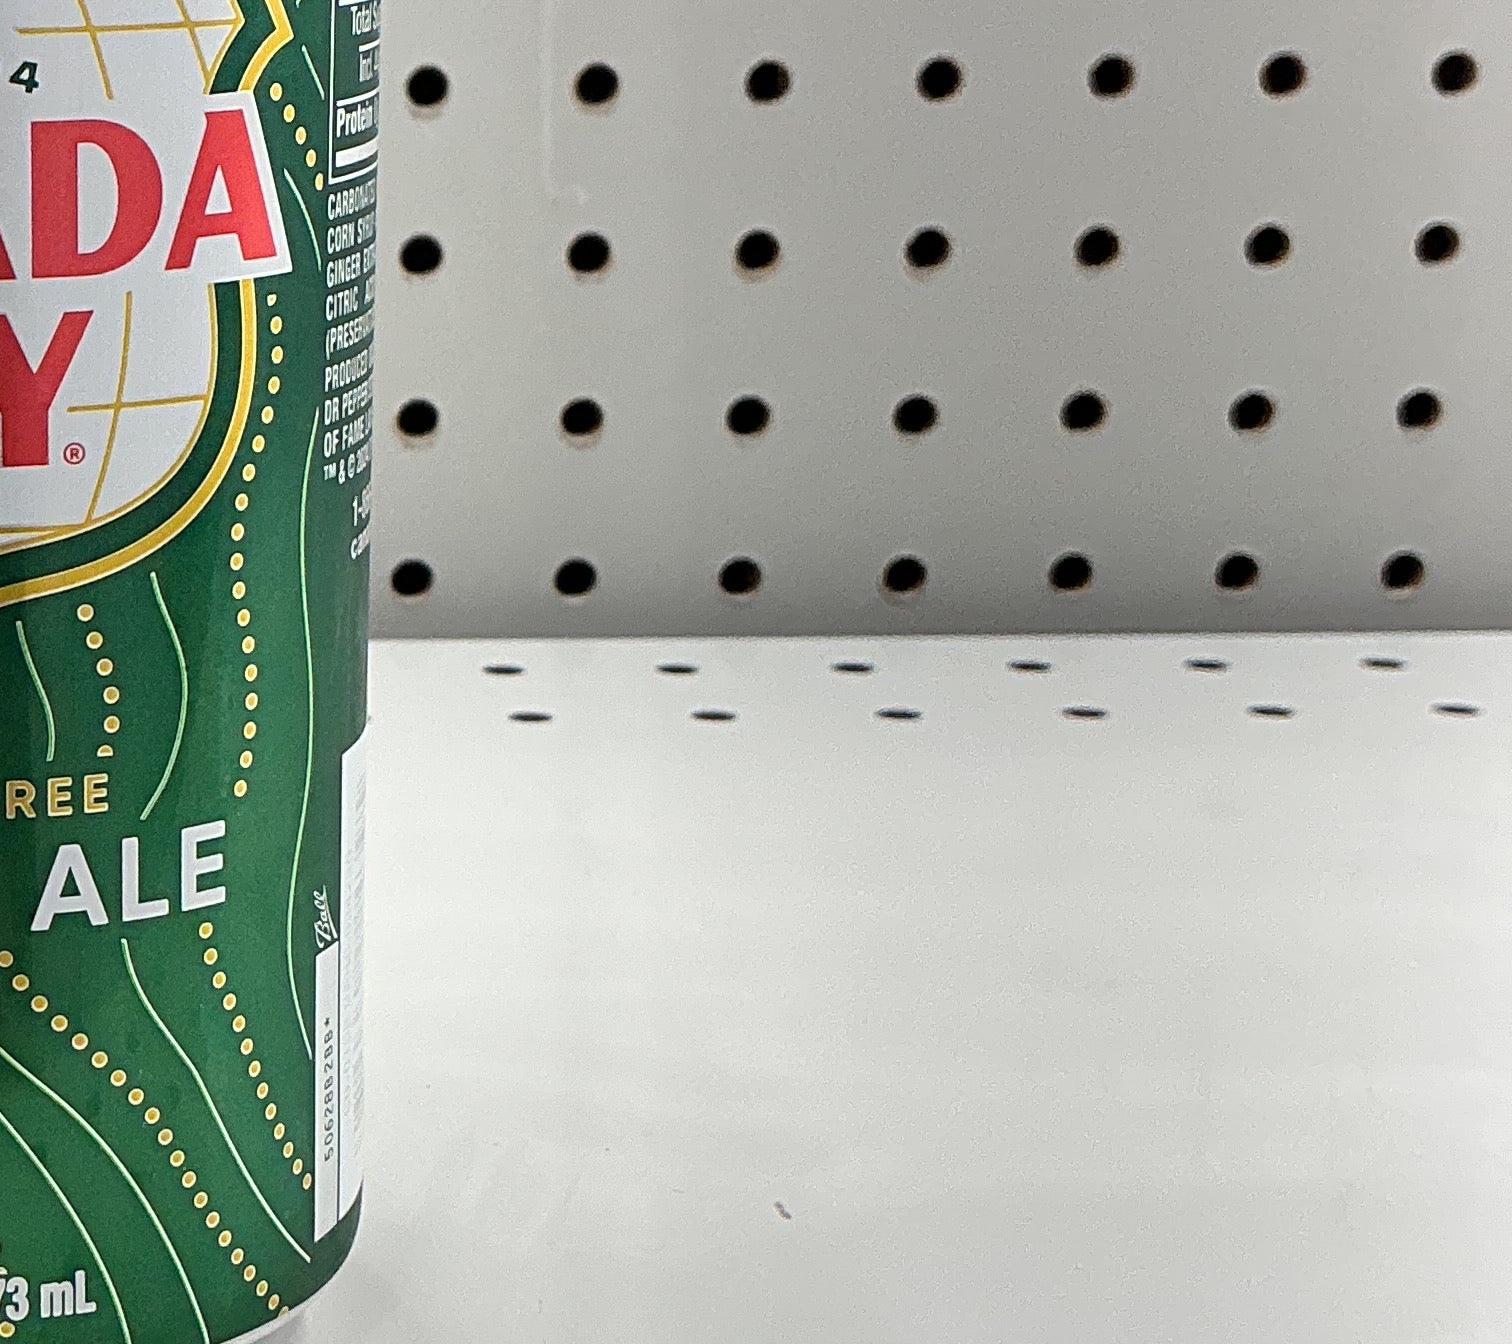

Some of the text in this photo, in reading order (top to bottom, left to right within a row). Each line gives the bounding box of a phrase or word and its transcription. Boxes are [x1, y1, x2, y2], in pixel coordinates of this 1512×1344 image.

[351, 4, 372, 37] Total
[336, 101, 373, 139] Protein
[327, 221, 355, 255] CORN
[326, 251, 361, 289] GINGER
[325, 286, 359, 322] CITRIC
[324, 396, 339, 426] DR
[323, 429, 339, 458] OF
[29, 819, 228, 934] ALE
[39, 1269, 97, 1319] mL
